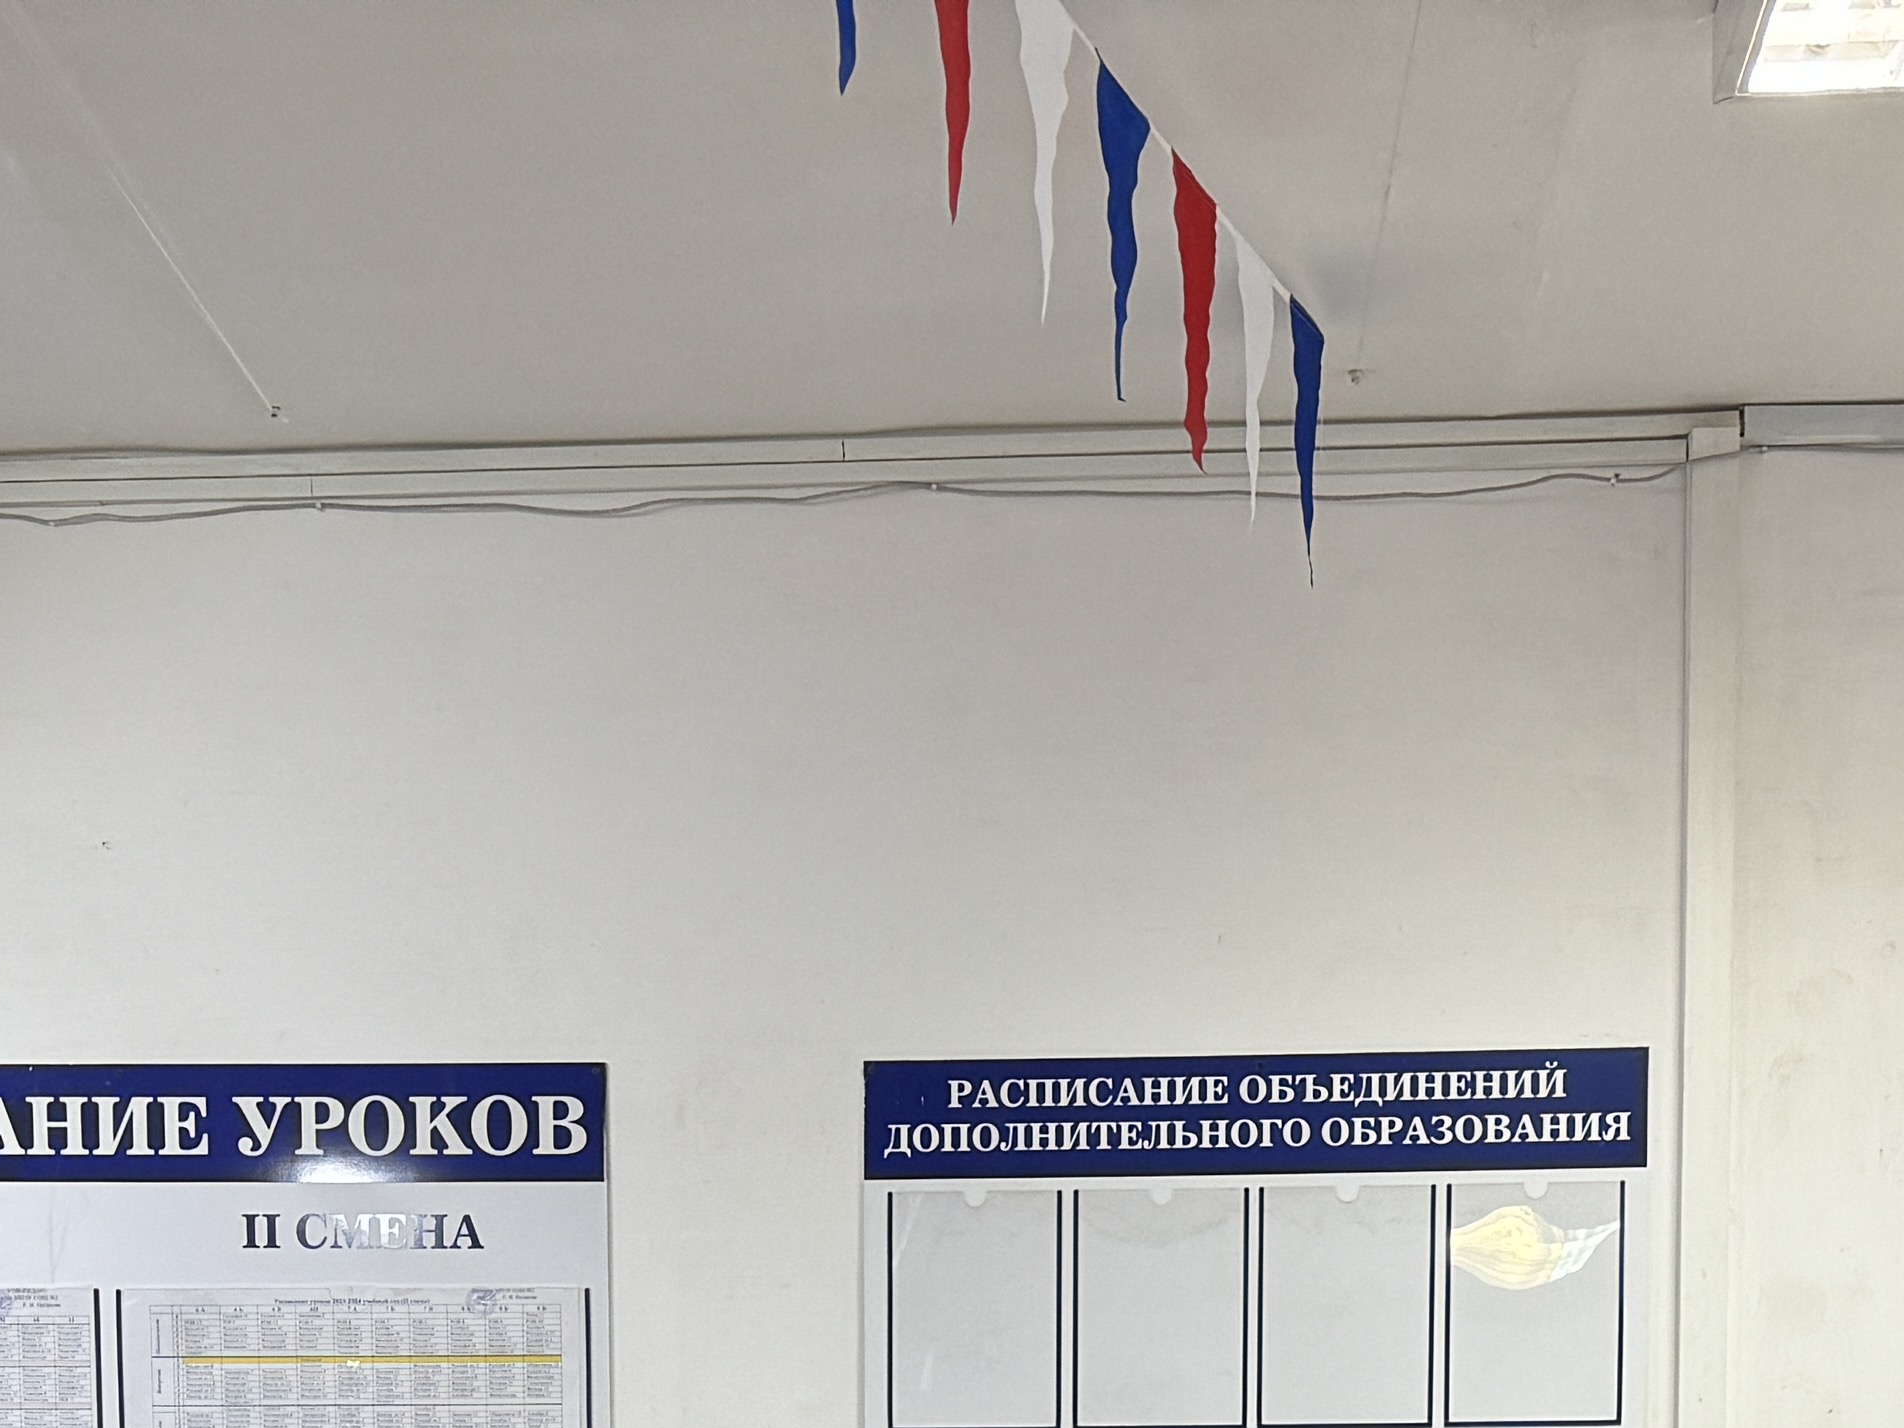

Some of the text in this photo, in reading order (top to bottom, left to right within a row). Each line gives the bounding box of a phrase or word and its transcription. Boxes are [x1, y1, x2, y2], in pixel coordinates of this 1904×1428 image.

[947, 1060, 1568, 1108] РАСПИСАНИЕ ОБЪЕДИНЕНИЙ
[231, 1094, 587, 1157] УРОКОВ
[883, 1111, 1632, 1158] ДОПОЛНИТЕЛЬНОГО ОБРАЗОВАНИЯ
[296, 1213, 485, 1250] СМЕНА
